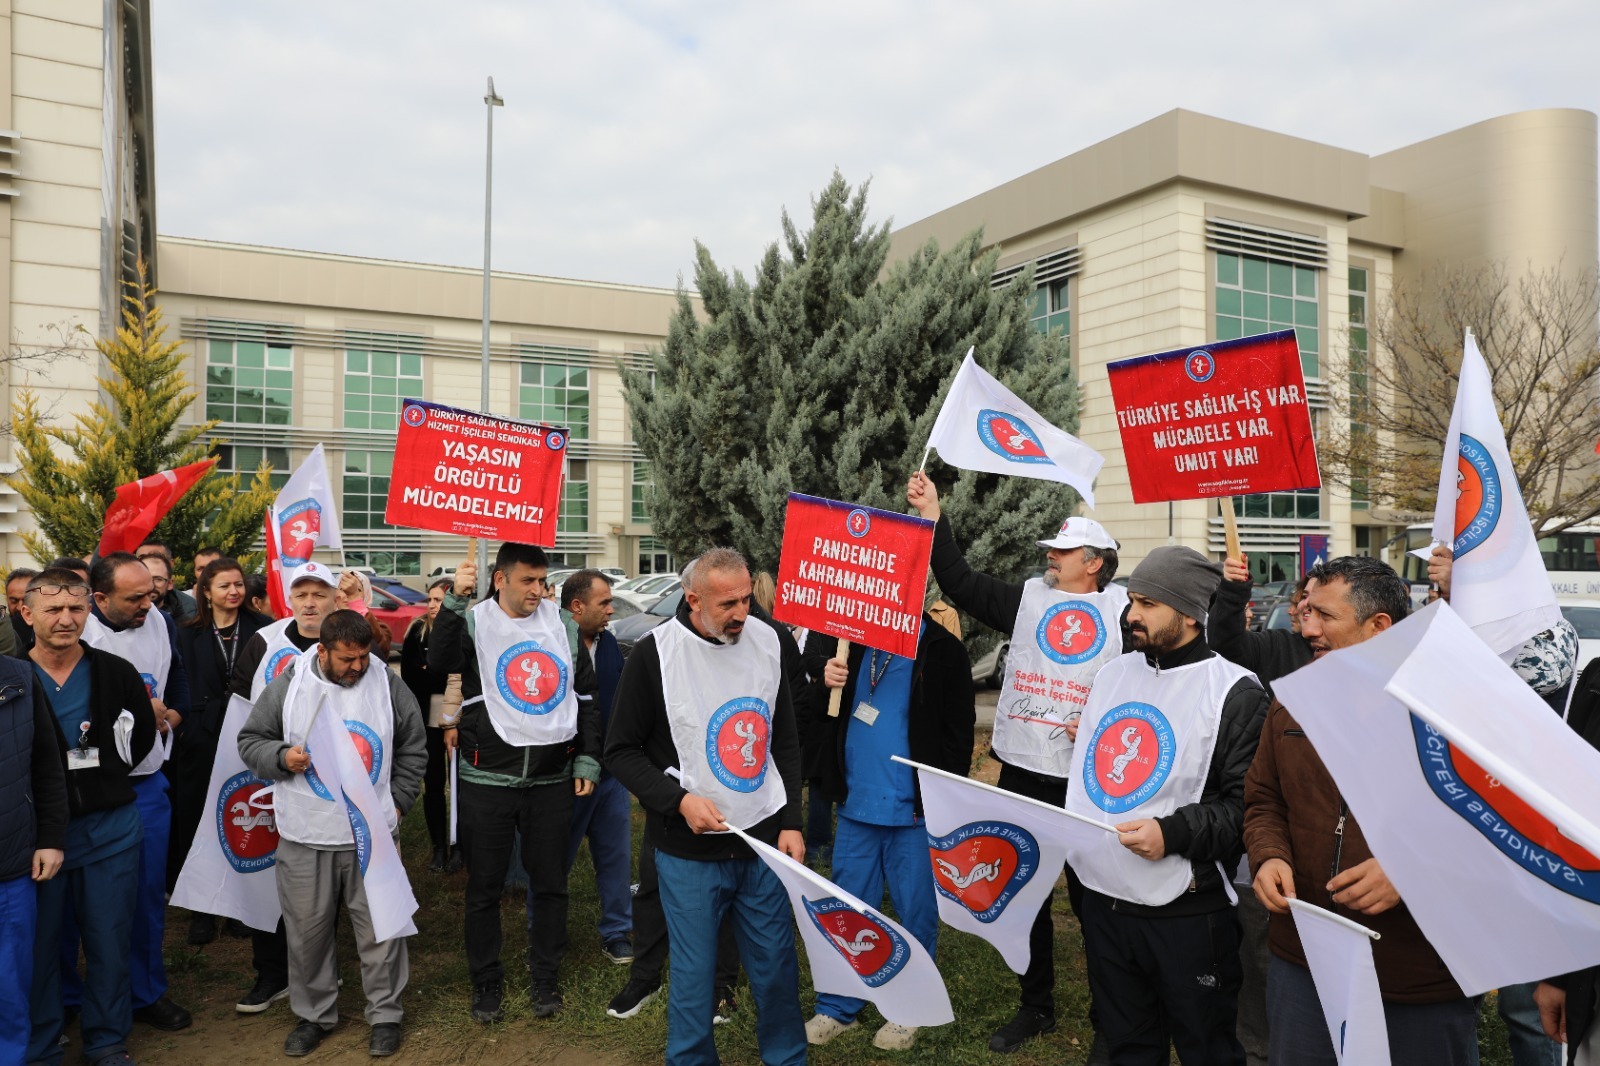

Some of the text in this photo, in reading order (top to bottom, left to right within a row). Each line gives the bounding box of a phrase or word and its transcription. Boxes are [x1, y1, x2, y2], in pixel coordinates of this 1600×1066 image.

[429, 408, 466, 423] TÜRKİYE
[467, 415, 497, 430] SAĞLIK
[499, 421, 510, 431] VE
[511, 423, 543, 437] SOSYAL
[1118, 384, 1306, 428] TÜRKİYE SAĞLIK-İŞ VAR,
[427, 420, 459, 434] HİZMET
[461, 425, 496, 440] İŞÇİLERİ
[497, 434, 541, 448] SENDİKASI
[1153, 417, 1274, 449] MÜCADELE VAR,
[443, 439, 522, 469] YAŞASIN
[1174, 446, 1259, 473] UMUT VAR!
[434, 461, 521, 495] ÖRGÜTLÜ
[403, 484, 544, 525] MÜCADELEMİZ!
[1484, 476, 1495, 518] HİZMET
[1453, 516, 1492, 554] İŞÇİLER
[812, 536, 897, 574] PANDEMİDE
[798, 560, 903, 606] KAHRAMANDIK,
[781, 580, 917, 635] ŞİMDİ UNUTULDUK!
[1015, 670, 1047, 684] Sağlık
[1051, 678, 1064, 687] ve
[712, 723, 720, 732] VE
[716, 704, 740, 722] SOSYAL
[1103, 715, 1114, 726] VE
[1114, 708, 1144, 720] SOSYAL
[1159, 732, 1172, 771] İŞÇİLERİ
[1124, 770, 1162, 806] SENDİKASI
[354, 826, 365, 863] HİZMET
